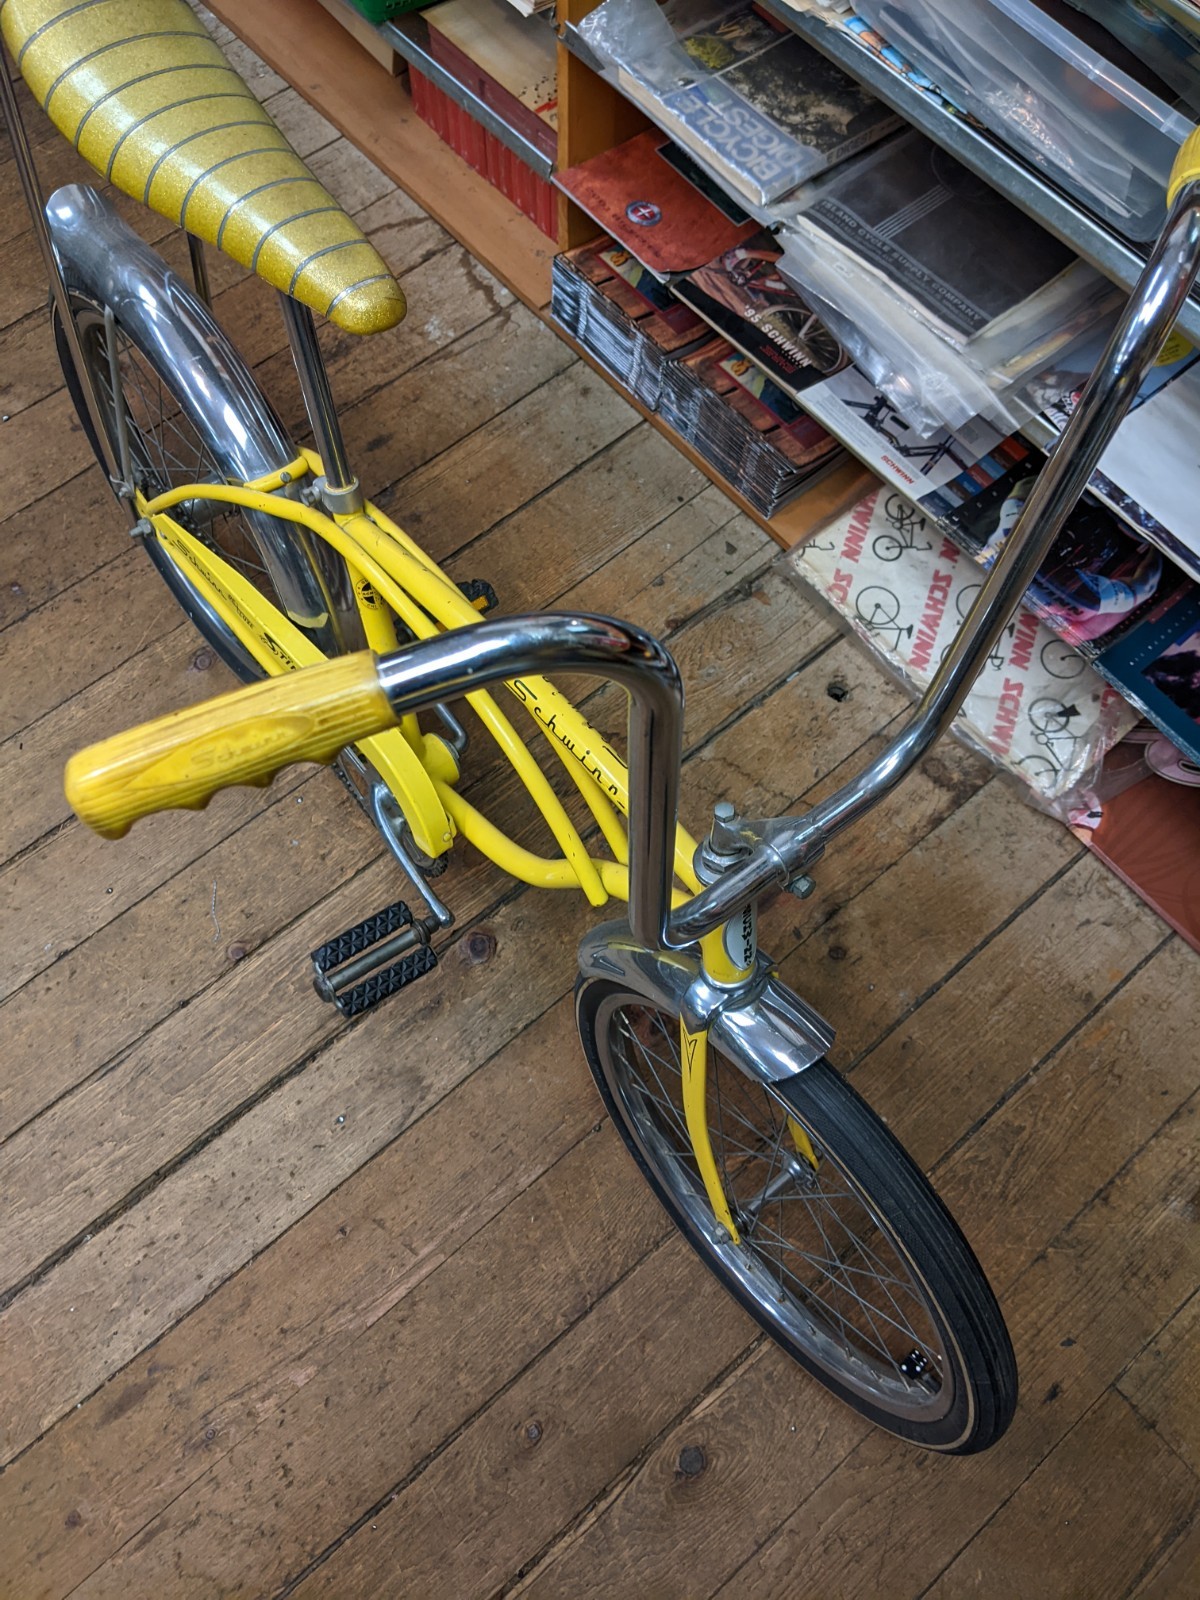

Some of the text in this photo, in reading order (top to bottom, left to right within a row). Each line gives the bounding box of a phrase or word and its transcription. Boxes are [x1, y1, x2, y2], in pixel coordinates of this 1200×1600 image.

[674, 93, 782, 182] BICYCLE
[707, 96, 804, 170] DIGEST
[821, 199, 982, 321] ISLAND CYCLE SUPPLY COMPANY
[743, 305, 762, 324] '95
[761, 323, 813, 368] SCHWINN
[880, 455, 915, 485] SCHWINN
[174, 540, 227, 599] Schwinn
[908, 569, 952, 672] SCHWINN
[190, 732, 290, 771] Schwinn
[503, 678, 625, 808] Schwinn
